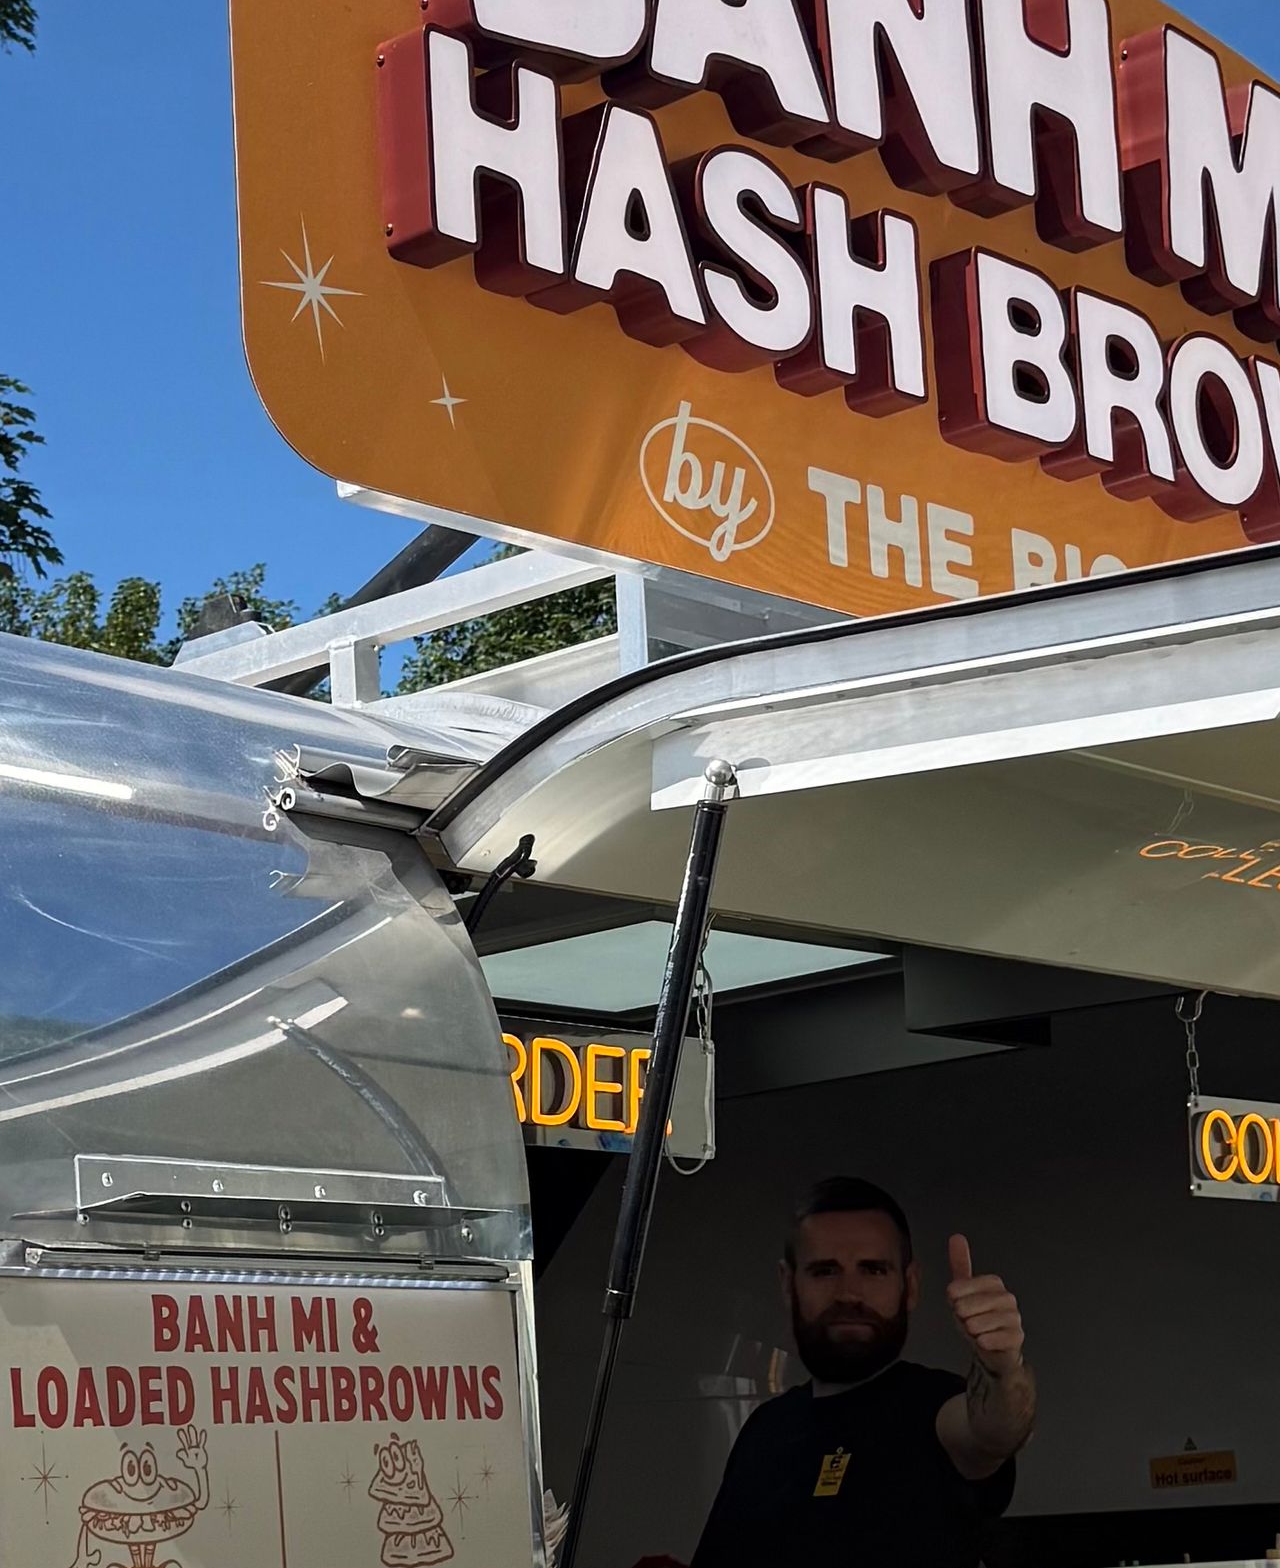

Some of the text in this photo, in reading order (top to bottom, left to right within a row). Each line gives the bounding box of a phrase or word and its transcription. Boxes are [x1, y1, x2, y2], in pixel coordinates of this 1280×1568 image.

[423, 23, 928, 407] HASH
[662, 401, 757, 562] by
[807, 465, 980, 601] THE
[501, 1033, 657, 1135] RDE
[152, 1294, 379, 1353] BANH MI &
[11, 1365, 502, 1427] LOADED HASHBROWNS
[1155, 1471, 1178, 1486] Hot
